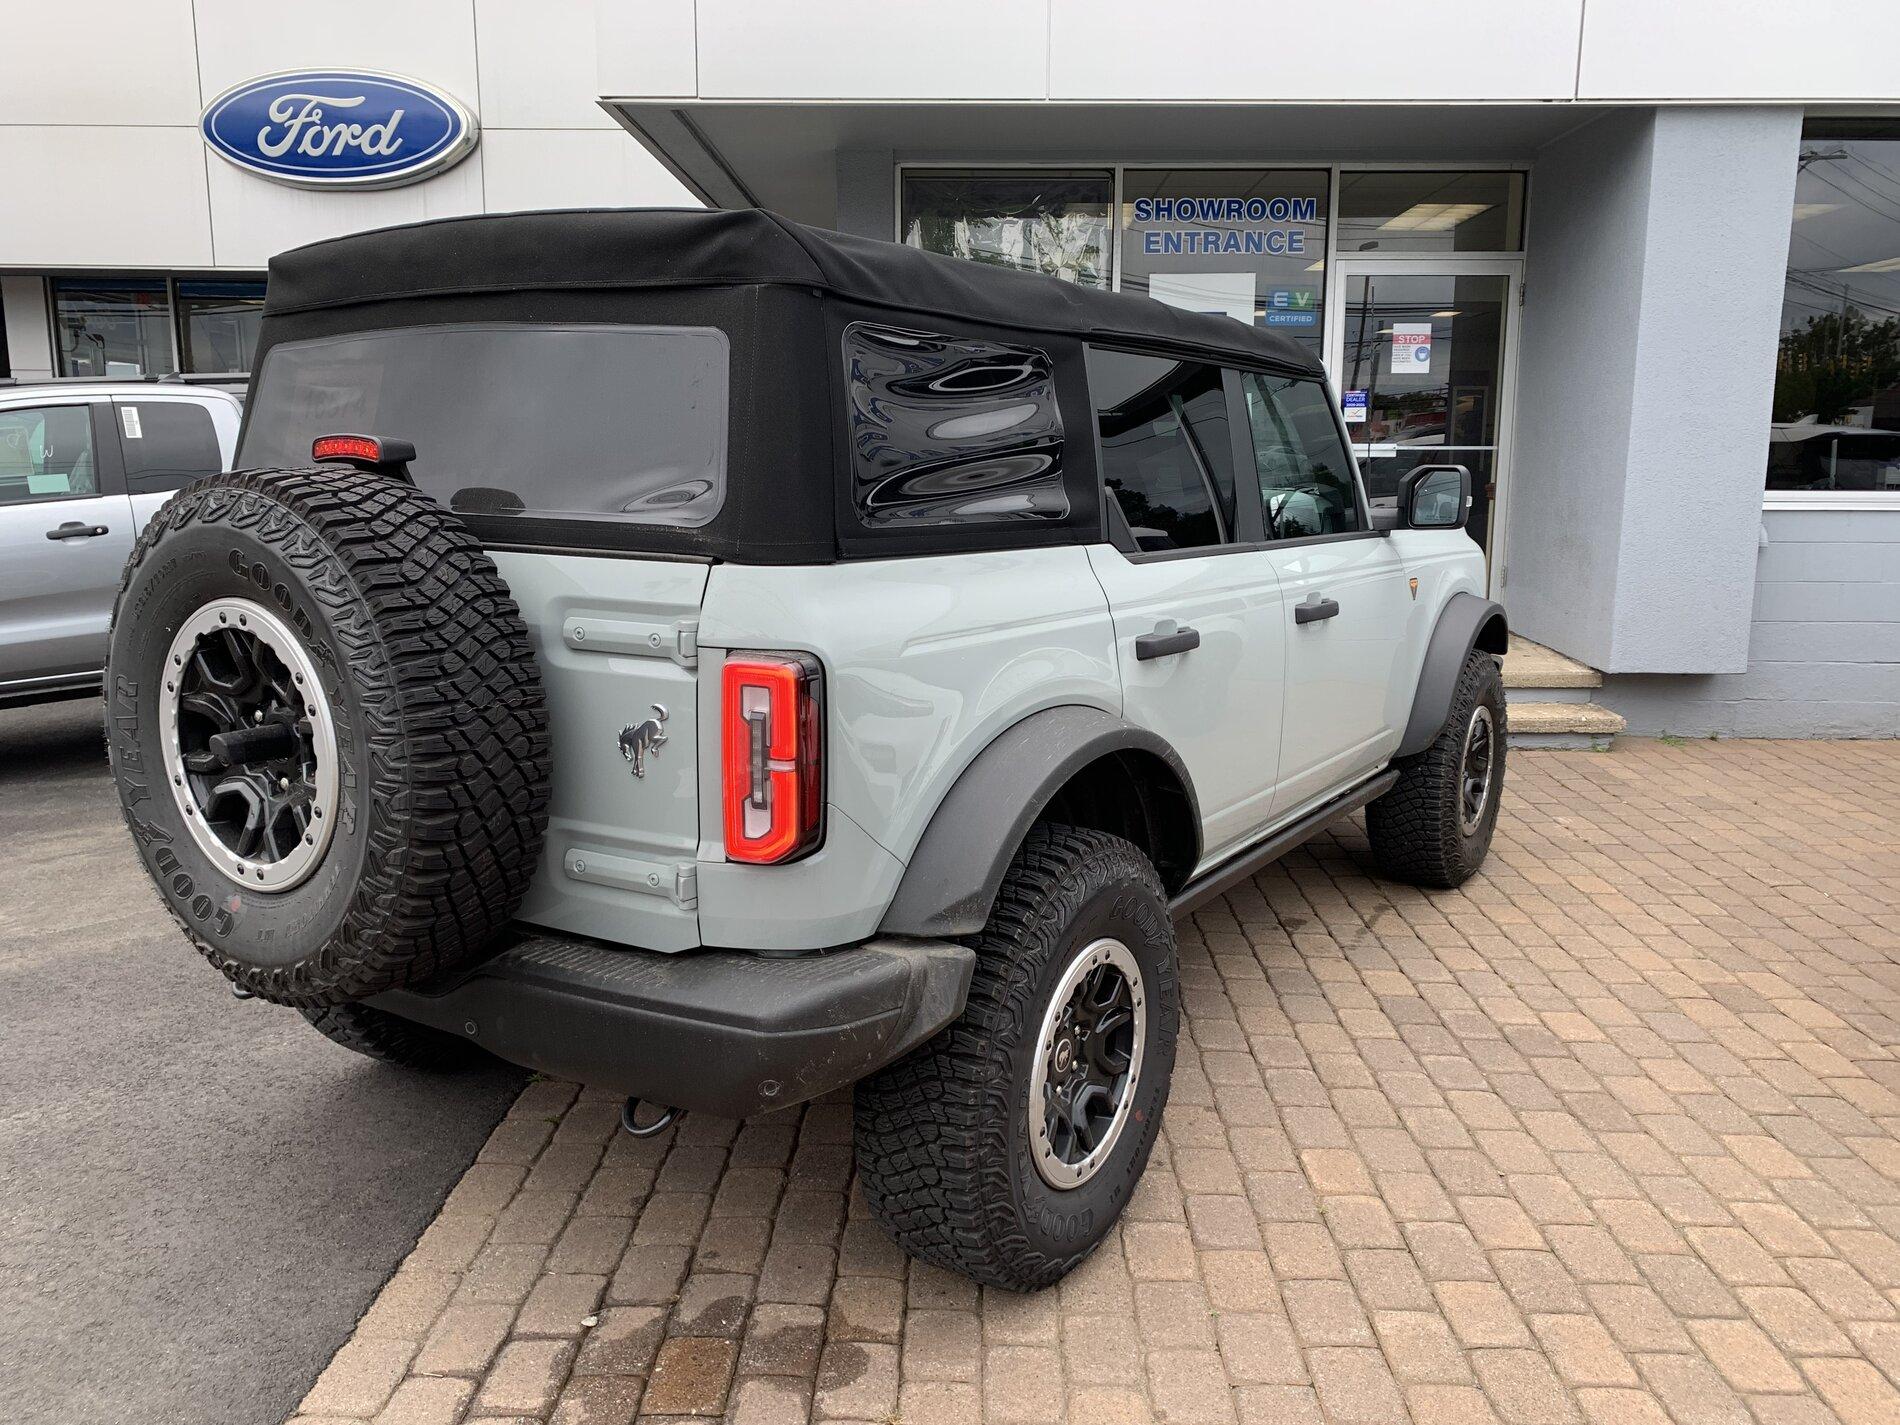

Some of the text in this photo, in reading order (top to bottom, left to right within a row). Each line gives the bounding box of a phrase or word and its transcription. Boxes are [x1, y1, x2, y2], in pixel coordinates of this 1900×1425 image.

[257, 94, 405, 158] Ford
[1134, 198, 1317, 223] SHOWROOM
[1143, 230, 1306, 255] ENTRANCE
[1398, 335, 1426, 344] STOP
